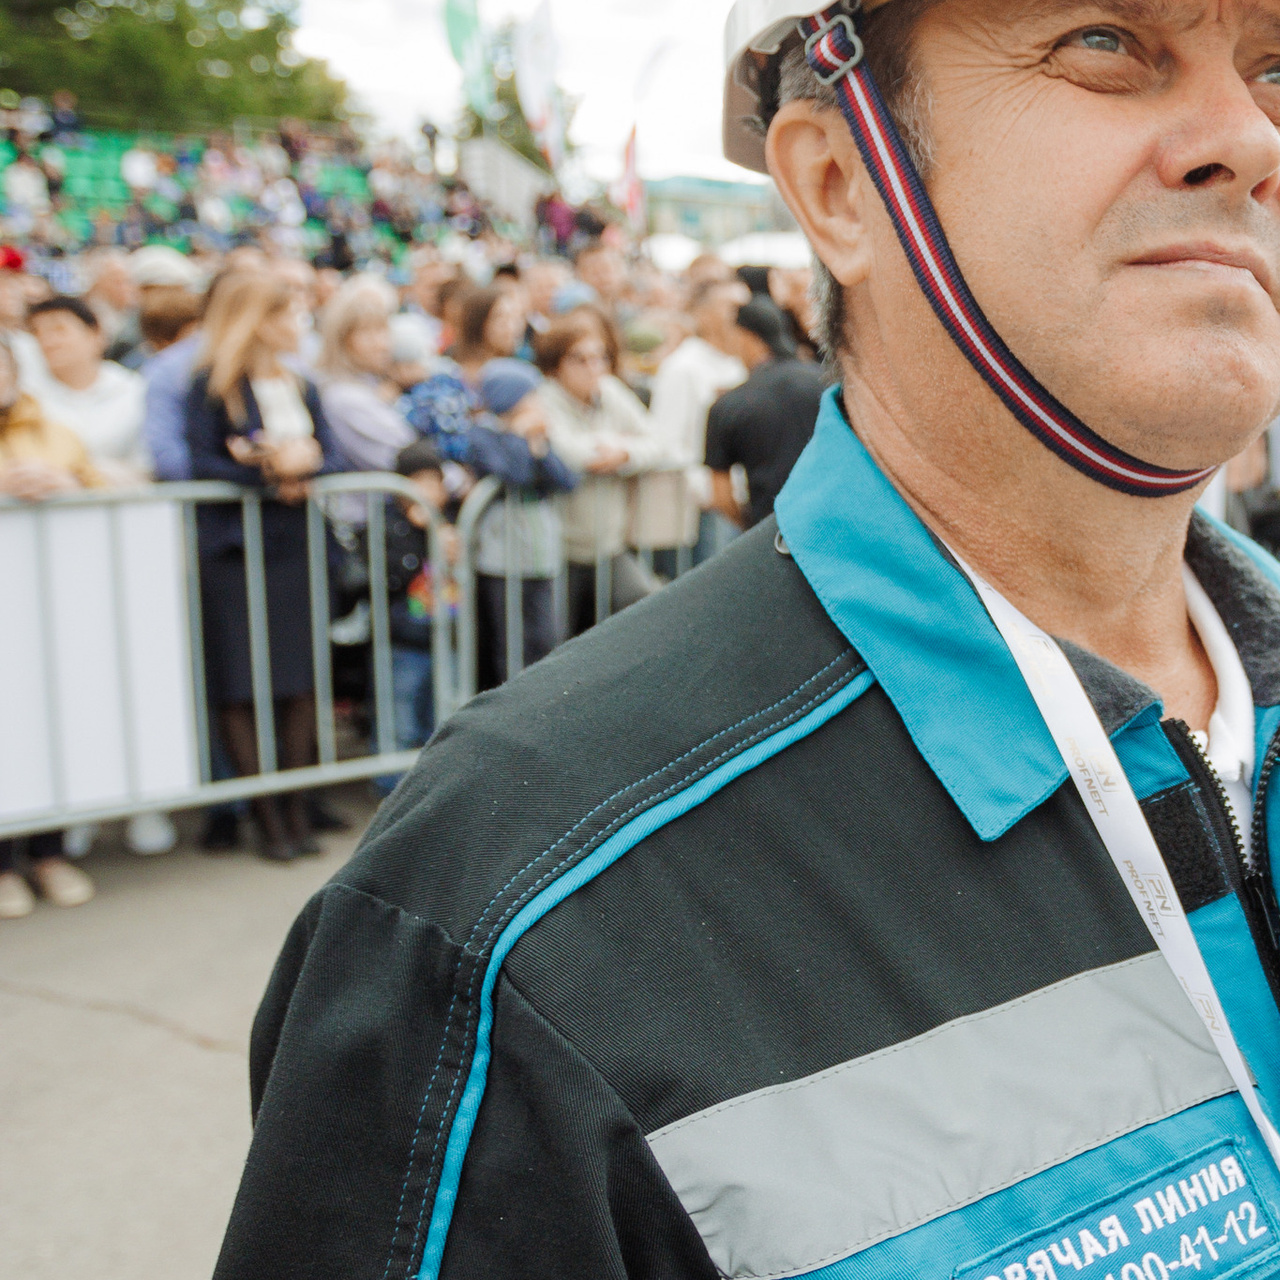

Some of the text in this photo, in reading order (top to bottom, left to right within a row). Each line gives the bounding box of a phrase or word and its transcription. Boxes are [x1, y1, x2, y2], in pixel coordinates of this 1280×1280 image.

[1065, 736, 1110, 817] PROFNEFT
[1122, 859, 1167, 940] PROFNEFT
[1132, 1155, 1248, 1236] ЛИНИЯ
